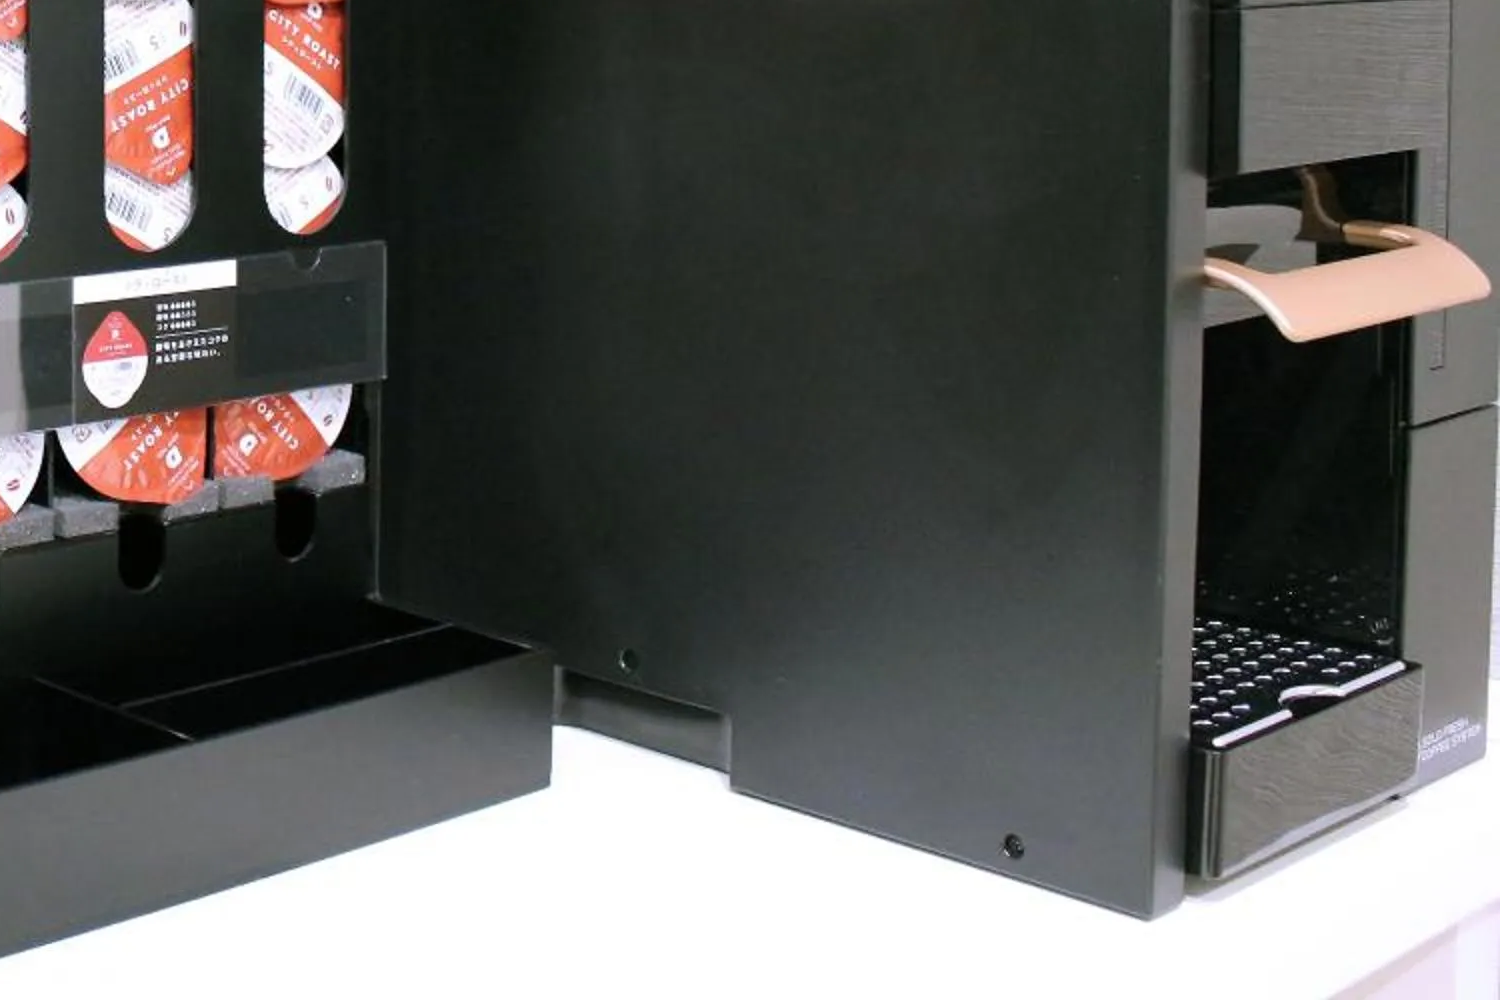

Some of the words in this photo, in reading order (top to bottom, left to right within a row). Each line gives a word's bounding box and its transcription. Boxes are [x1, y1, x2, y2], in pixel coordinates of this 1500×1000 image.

[268, 9, 300, 35] CITY
[303, 35, 341, 71] ROAST
[161, 77, 190, 105] CITY
[110, 99, 157, 133] ROAST
[123, 425, 163, 471] ROAST
[272, 421, 299, 450] CITY
